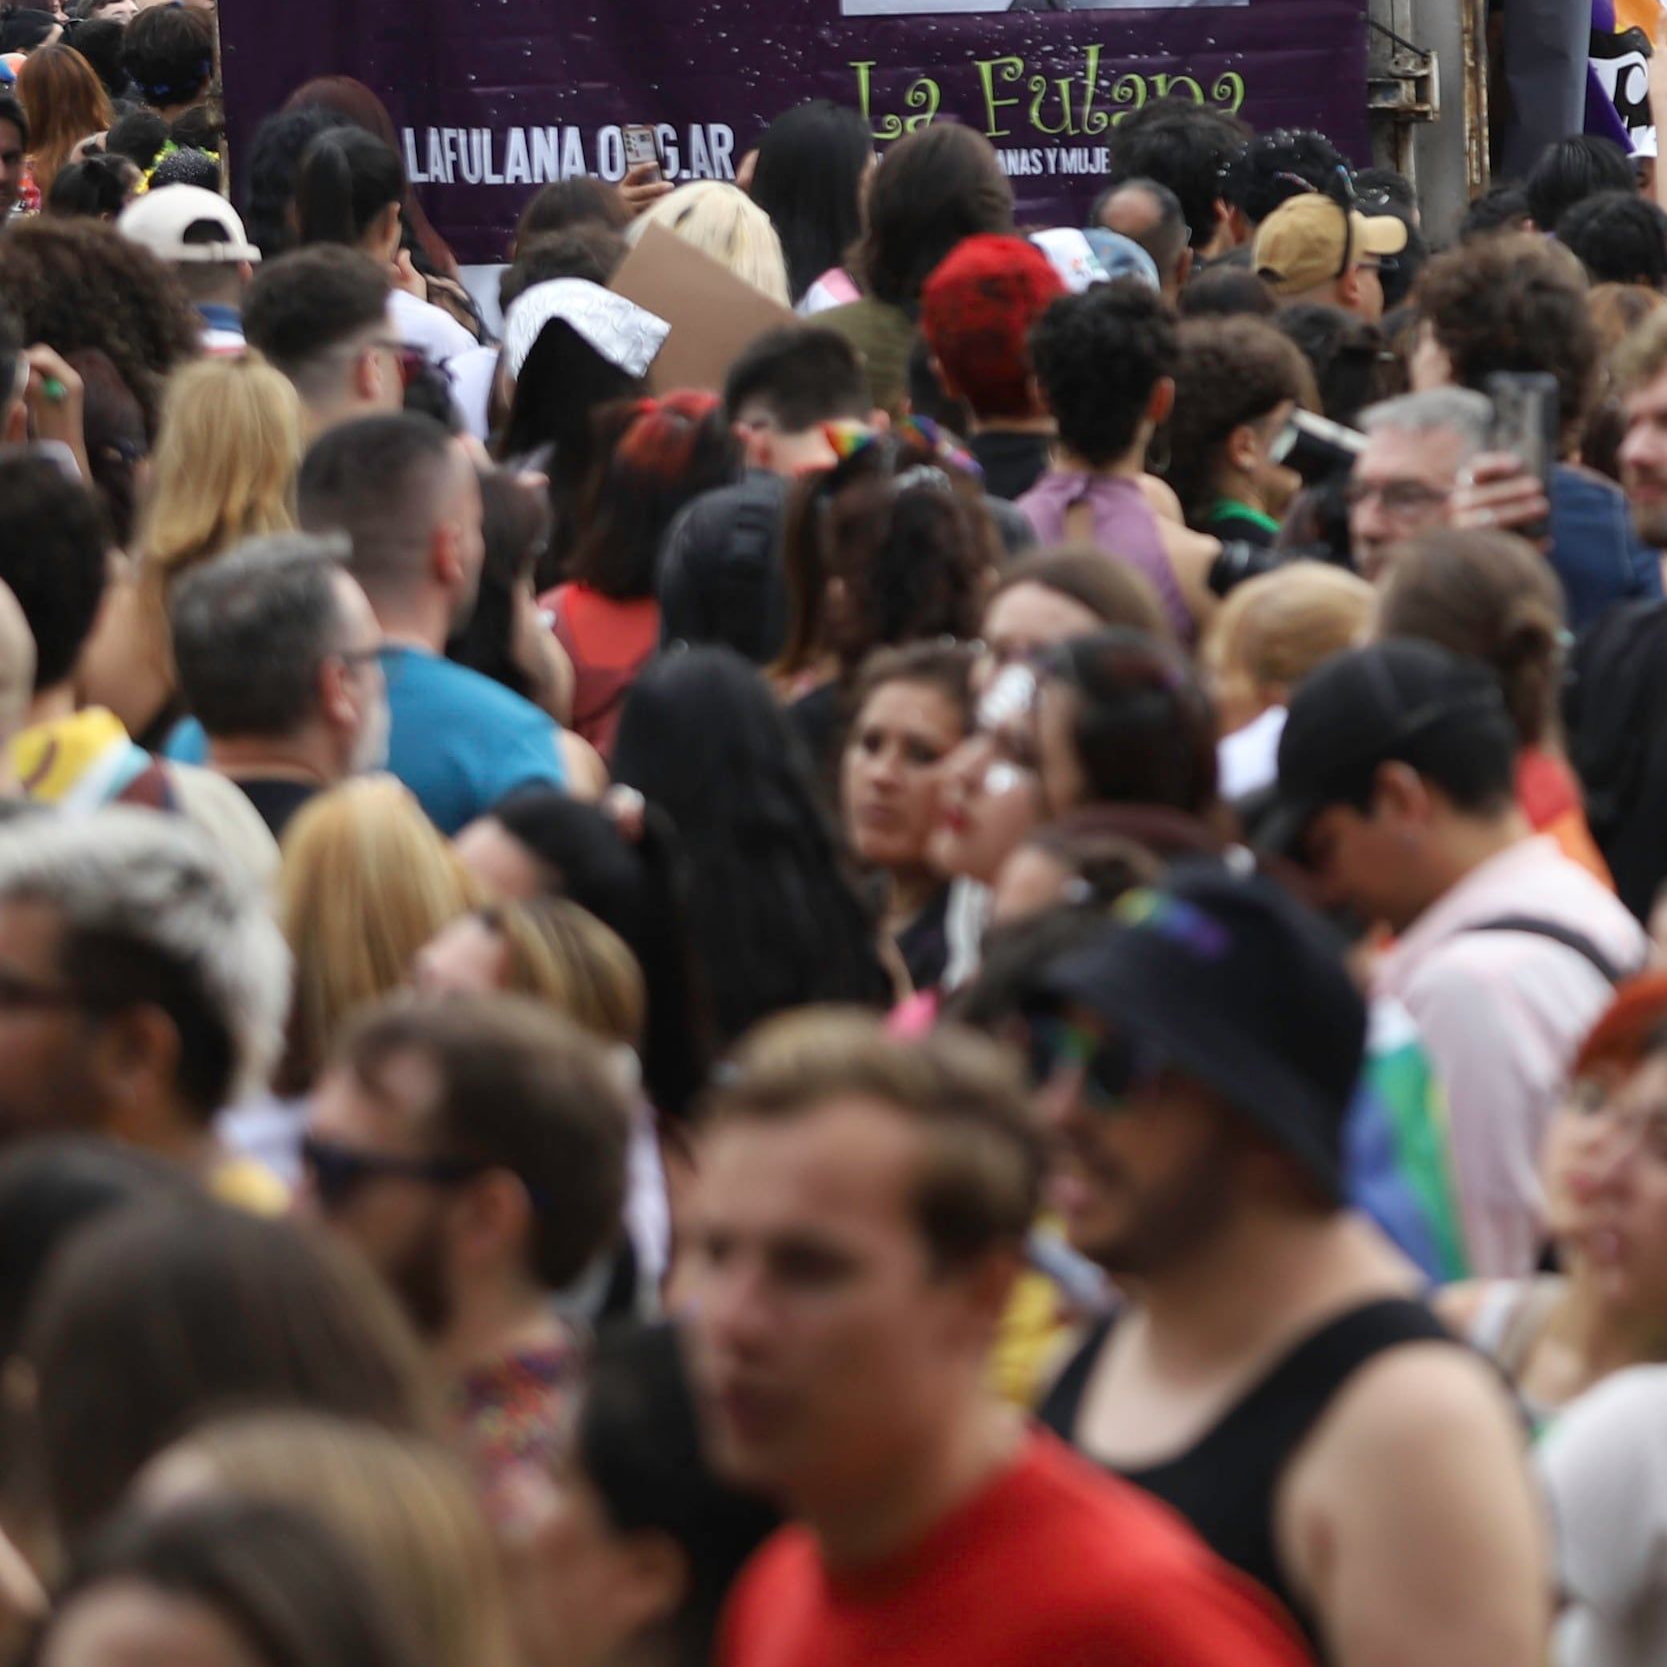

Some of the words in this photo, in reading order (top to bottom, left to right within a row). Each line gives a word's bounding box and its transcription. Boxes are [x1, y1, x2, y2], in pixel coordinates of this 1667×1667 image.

[848, 60, 941, 140] La
[402, 123, 736, 185] LAFULANA.OG.AR
[1061, 147, 1111, 175] MUJE
